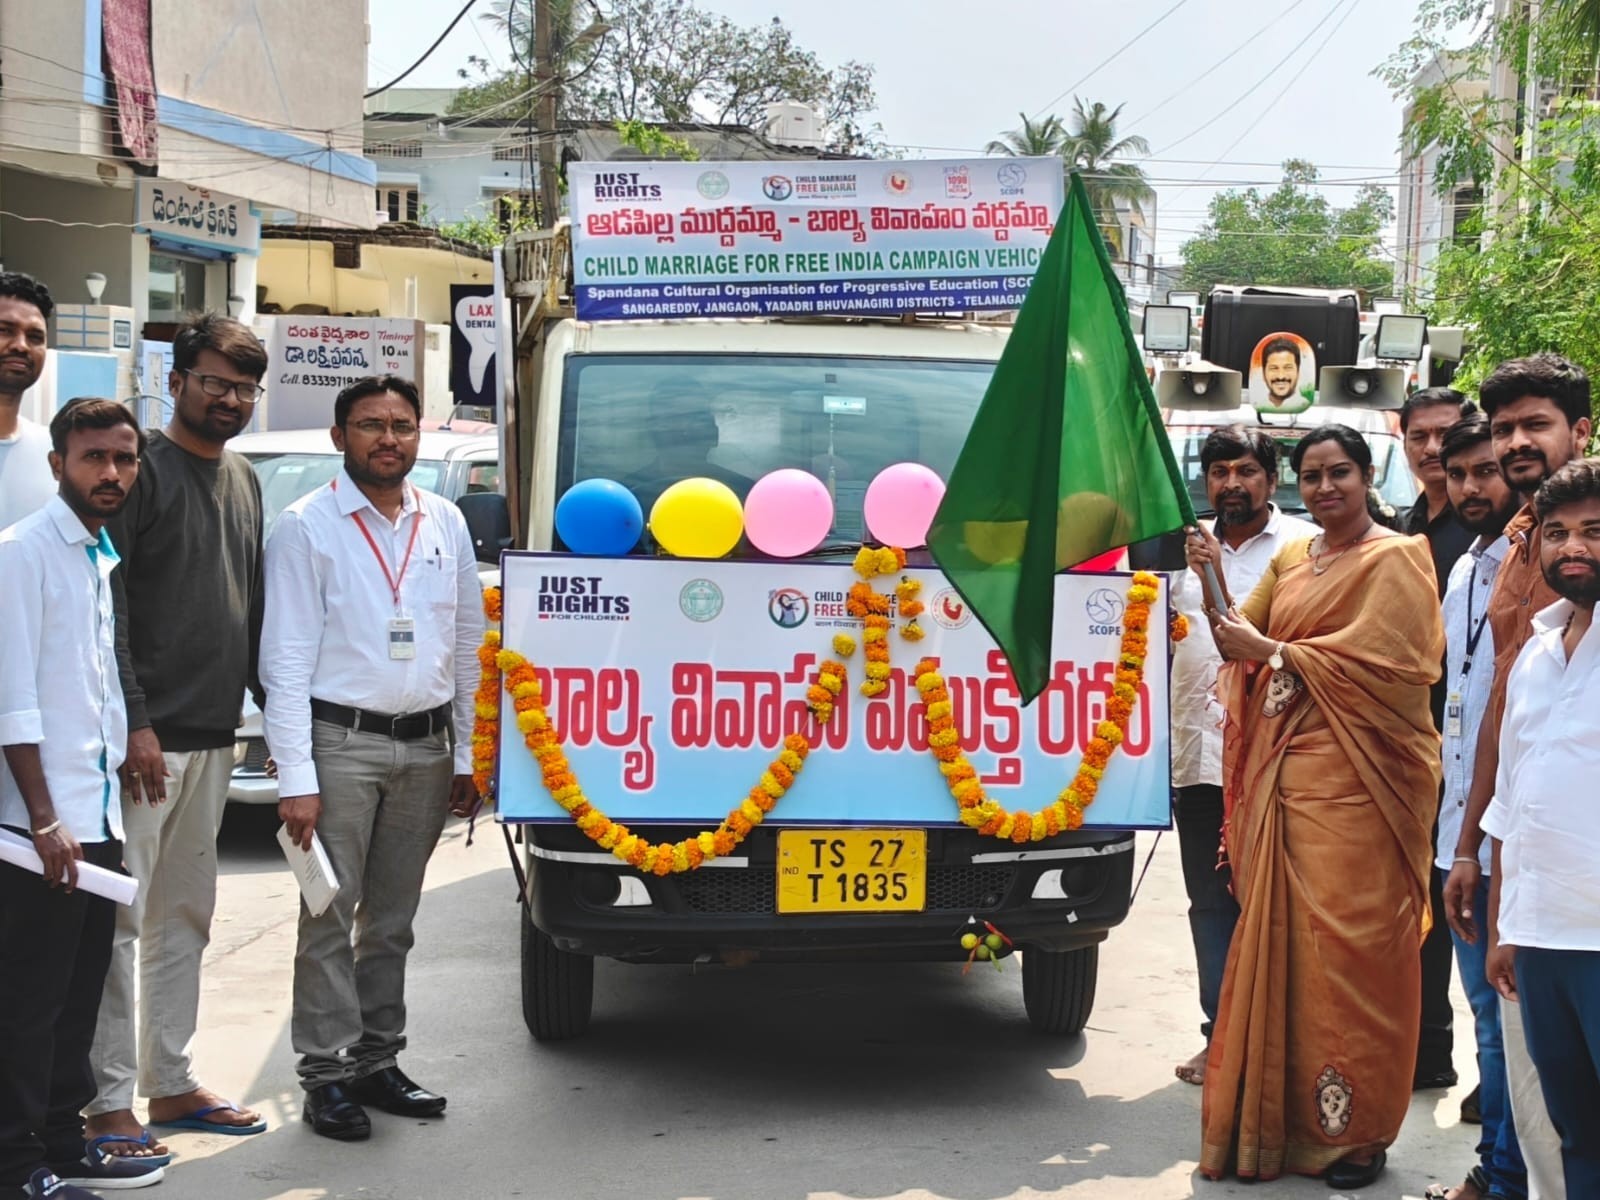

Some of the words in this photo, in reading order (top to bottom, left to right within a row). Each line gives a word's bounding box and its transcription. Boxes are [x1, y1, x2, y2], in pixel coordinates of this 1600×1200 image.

[594, 173, 640, 185] JUST
[818, 174, 857, 182] MARRIAGE
[594, 185, 661, 197] RIGHTS
[796, 184, 818, 192] FREE
[820, 183, 857, 192] BHARAT
[587, 208, 674, 243] ఆడపిల్ల
[808, 209, 867, 243] బాల్య
[871, 203, 966, 230] వివాహం
[584, 256, 638, 277] CHILD
[645, 254, 738, 276] MARRIAGE
[745, 254, 780, 274] FOR
[785, 252, 829, 273] FREE
[835, 251, 884, 271] INDIA
[889, 248, 980, 270] CAMPAIGN
[986, 247, 1043, 267] VEHIC
[587, 287, 659, 300] Spandana
[663, 285, 720, 298] Cultural
[724, 282, 815, 298] Organisation
[819, 282, 837, 294] for
[843, 279, 925, 294] Progressive
[929, 277, 998, 291] Education
[469, 304, 493, 316] LAX
[622, 302, 701, 315] SANGAREDDY,
[704, 301, 762, 314] JANGAON,
[765, 300, 813, 312] YADADRI
[817, 297, 894, 311] BHUVANAGIRI
[897, 295, 955, 308] DISTRICTS
[382, 345, 395, 357] 10
[386, 361, 400, 369] TO
[538, 576, 603, 594] JUST
[814, 591, 843, 602] CHILD
[538, 594, 630, 614] RIGHTS
[814, 604, 844, 616] FREE
[1088, 625, 1121, 636] SCOPE
[810, 838, 846, 868] TS
[869, 839, 904, 868] 27
[782, 867, 799, 875] IND
[807, 873, 824, 903] T
[836, 872, 908, 902] 1835
